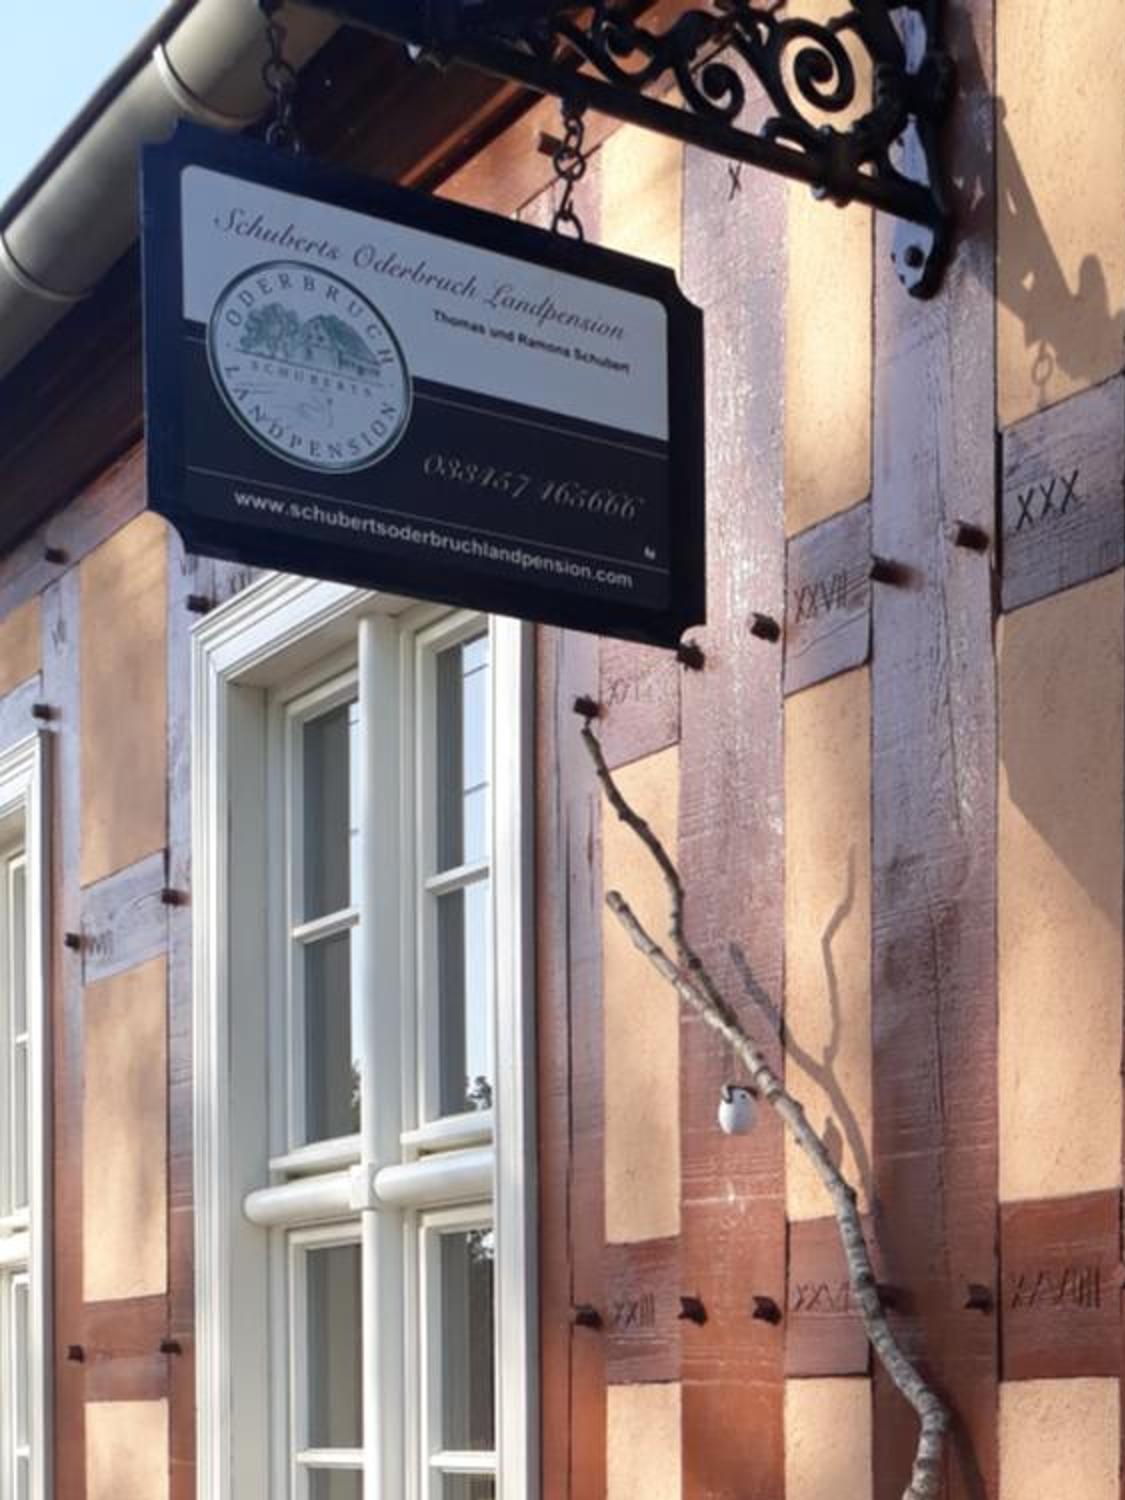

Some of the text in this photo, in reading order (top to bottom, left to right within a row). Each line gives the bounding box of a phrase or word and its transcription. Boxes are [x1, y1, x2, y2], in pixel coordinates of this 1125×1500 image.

[213, 208, 625, 342] Schuberts Oderbruch Landpension
[225, 272, 395, 358] ODERBRUCH
[432, 308, 631, 375] Thomas und Ramona Schubert
[224, 365, 397, 460] LANDPENSION
[233, 491, 634, 589] www.schubertsoderbruchlandpension.com
